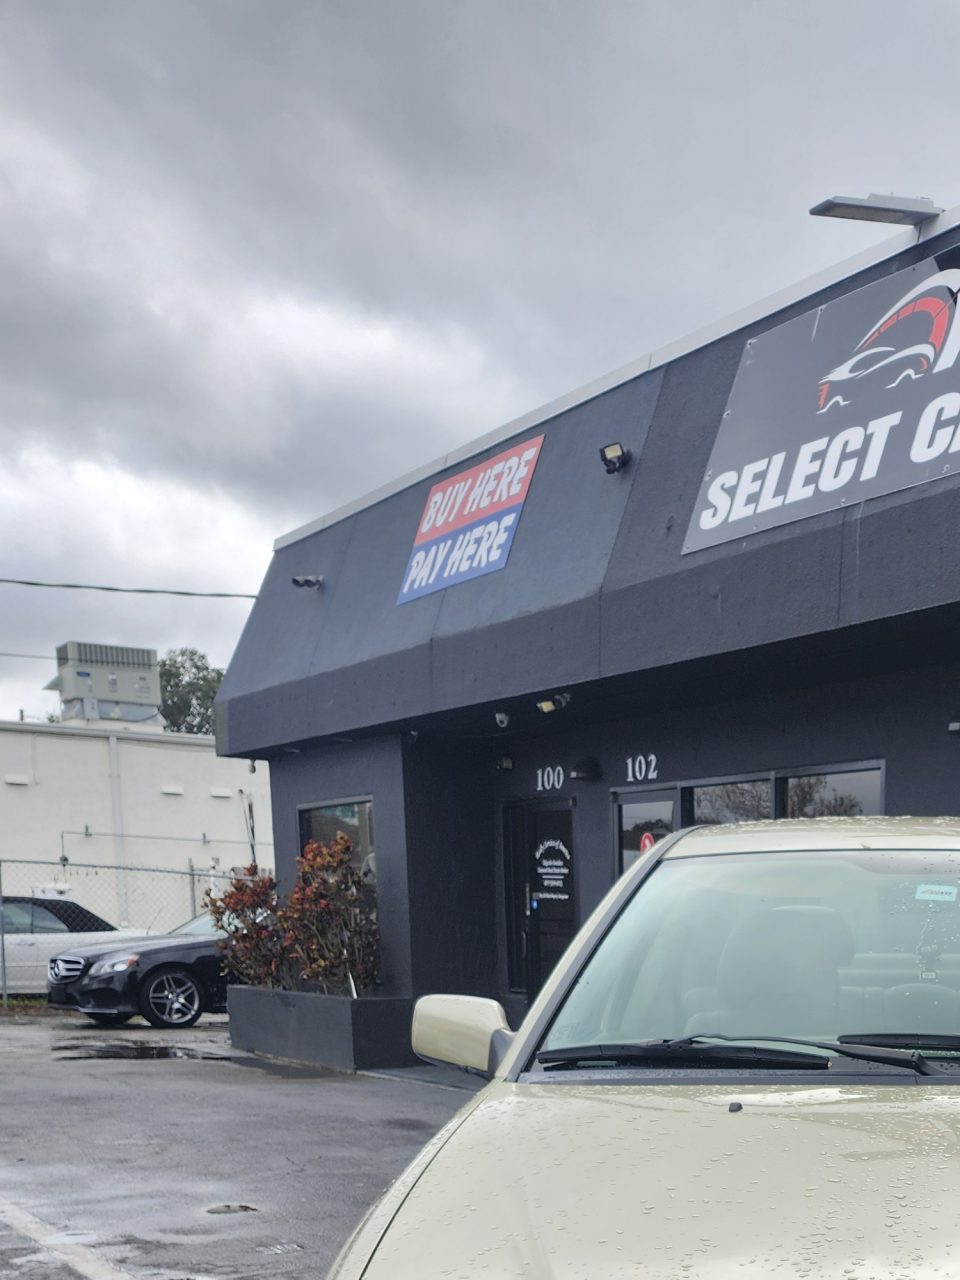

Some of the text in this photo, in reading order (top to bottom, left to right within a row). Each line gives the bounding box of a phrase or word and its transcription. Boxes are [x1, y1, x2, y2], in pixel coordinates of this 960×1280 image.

[421, 447, 537, 534] BUY HERE
[699, 411, 902, 530] SELECT
[402, 512, 516, 593] PAY HERE
[536, 766, 564, 791] 100
[626, 754, 658, 782] 102
